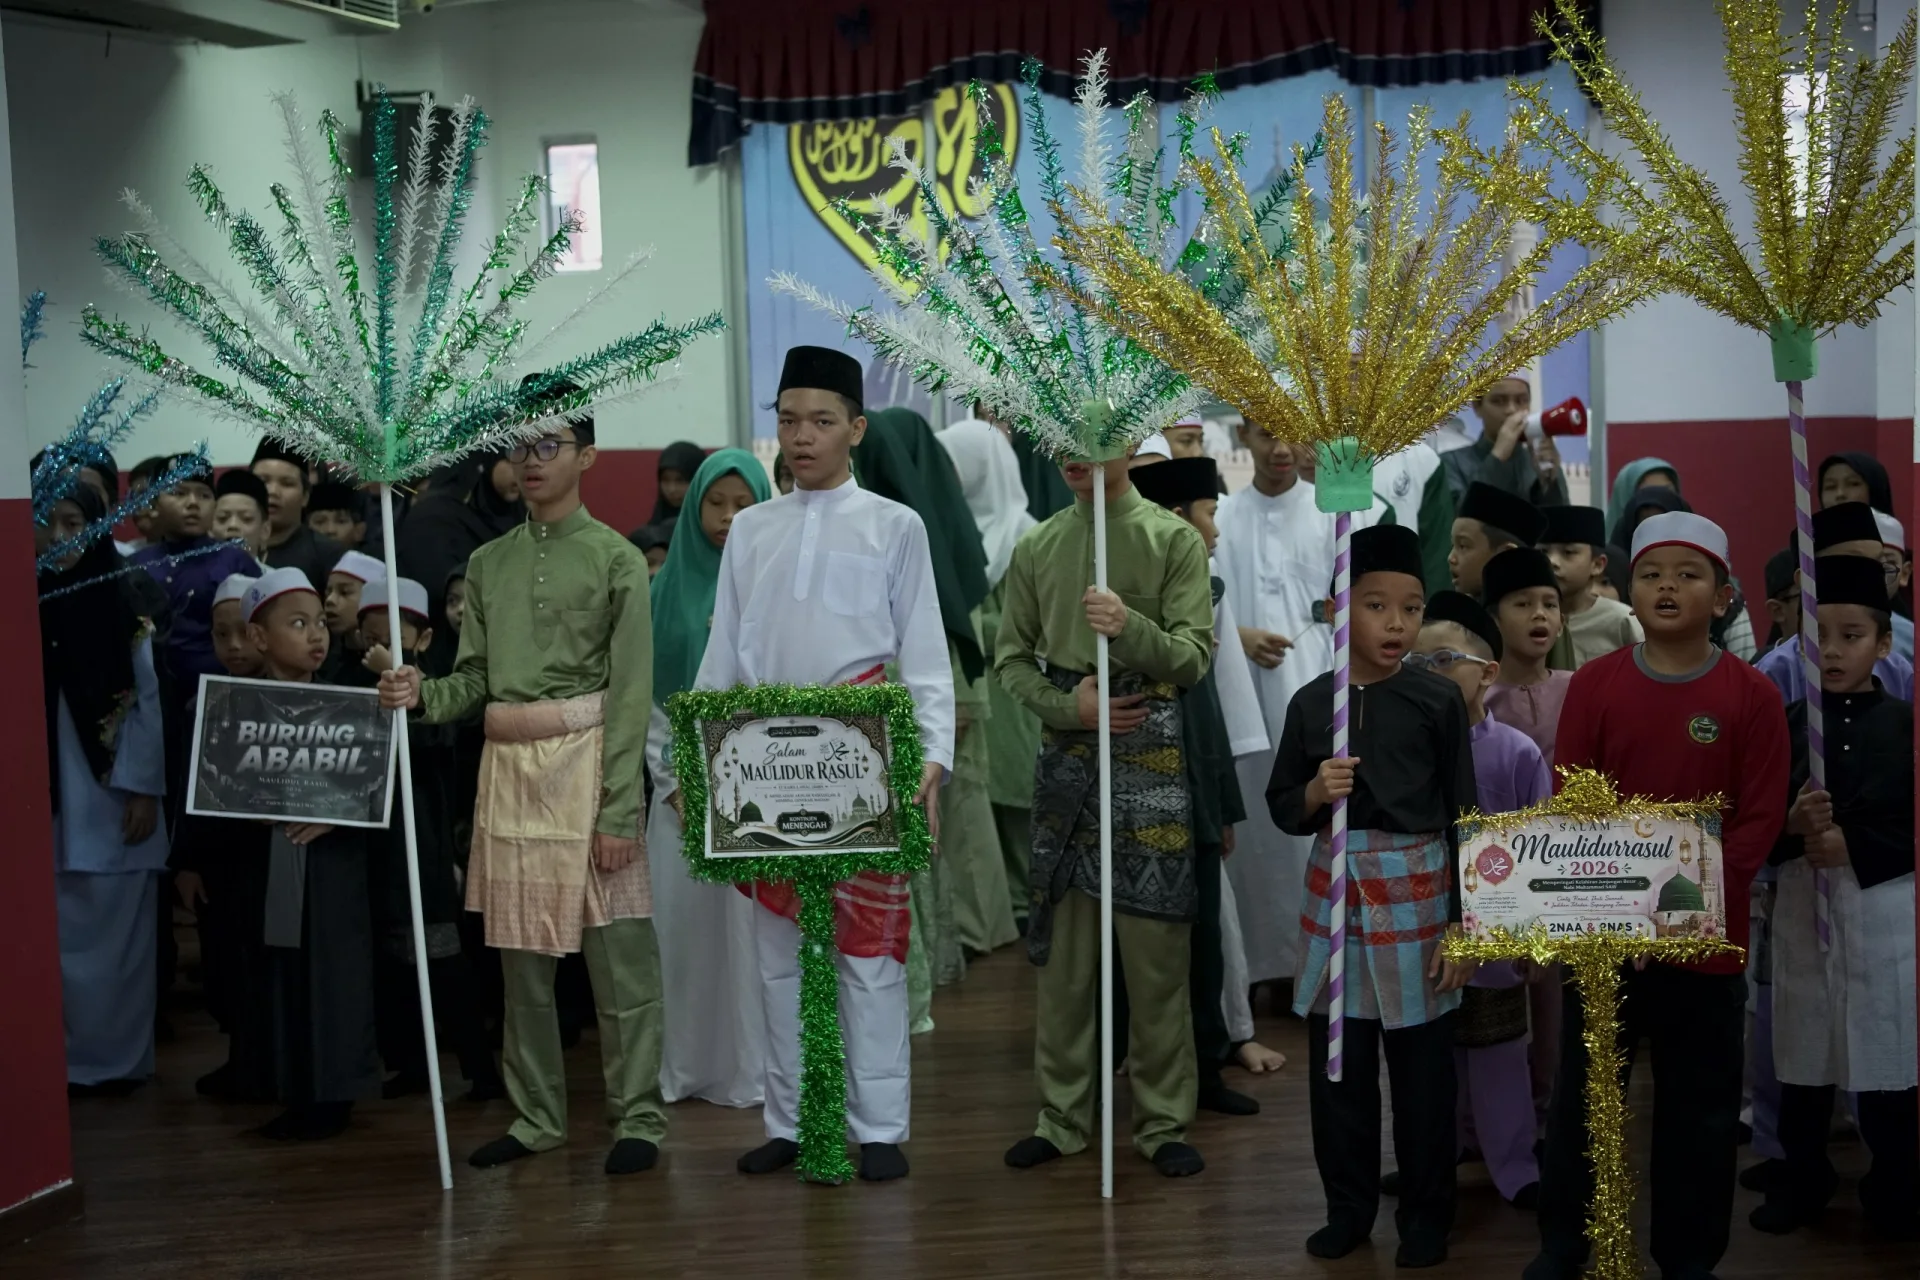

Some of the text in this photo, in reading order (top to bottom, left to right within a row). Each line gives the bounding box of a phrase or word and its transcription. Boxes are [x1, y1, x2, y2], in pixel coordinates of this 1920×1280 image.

[237, 720, 355, 746] BURUNG
[235, 745, 368, 775] ABABIL
[763, 741, 807, 765] Salam
[740, 761, 864, 785] MAULIDUR RASUL
[782, 821, 827, 830] MENENGAH
[1559, 822, 1611, 832] SALAM
[1511, 833, 1674, 865] Maulidurrasul
[1569, 861, 1619, 876] 2026
[1549, 922, 1582, 932] 2NAA
[1586, 922, 1595, 932] &
